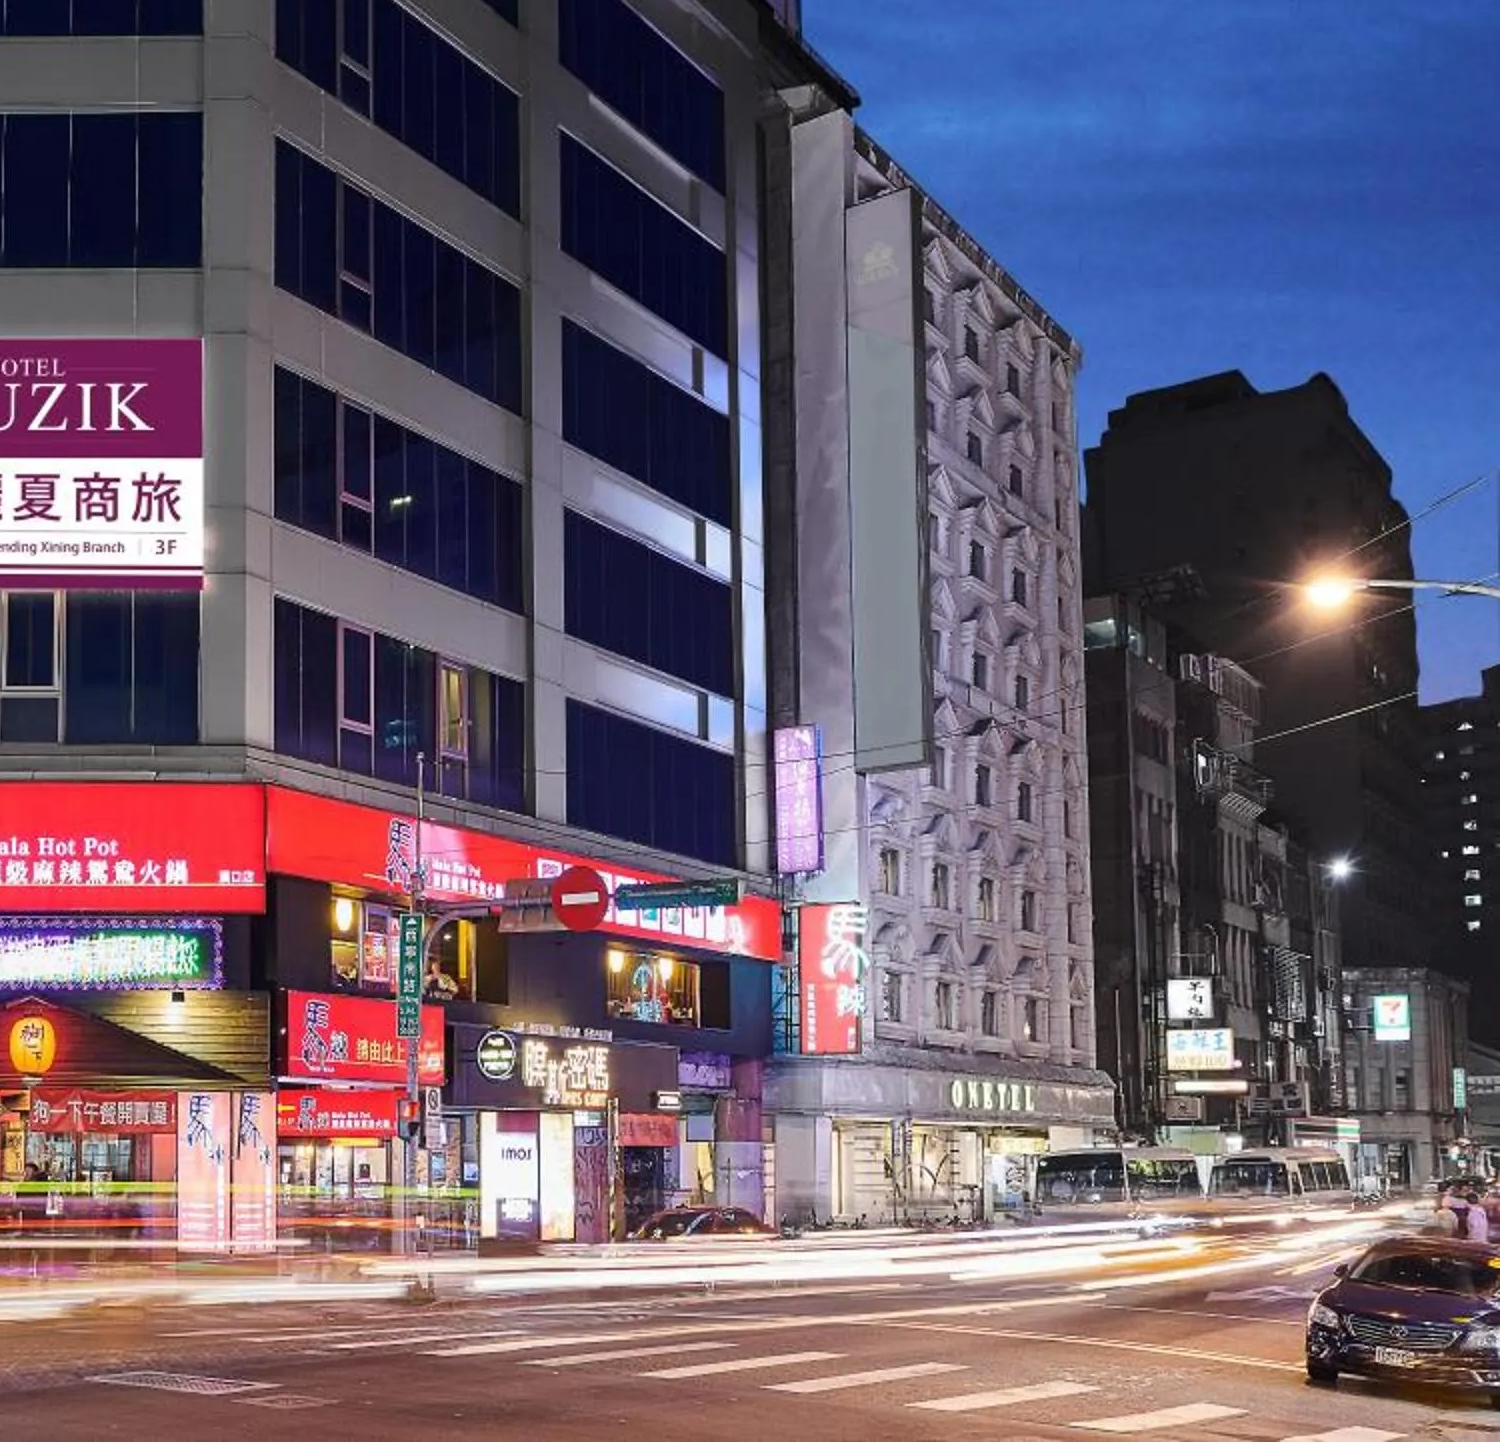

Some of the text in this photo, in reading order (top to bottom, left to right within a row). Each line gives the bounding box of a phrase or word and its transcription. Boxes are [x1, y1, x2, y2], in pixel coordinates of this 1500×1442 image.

[40, 540, 79, 556] Xining
[83, 540, 125, 553] Branch
[155, 539, 177, 555] 3F
[38, 837, 76, 856] Hot
[83, 837, 119, 856] Pot
